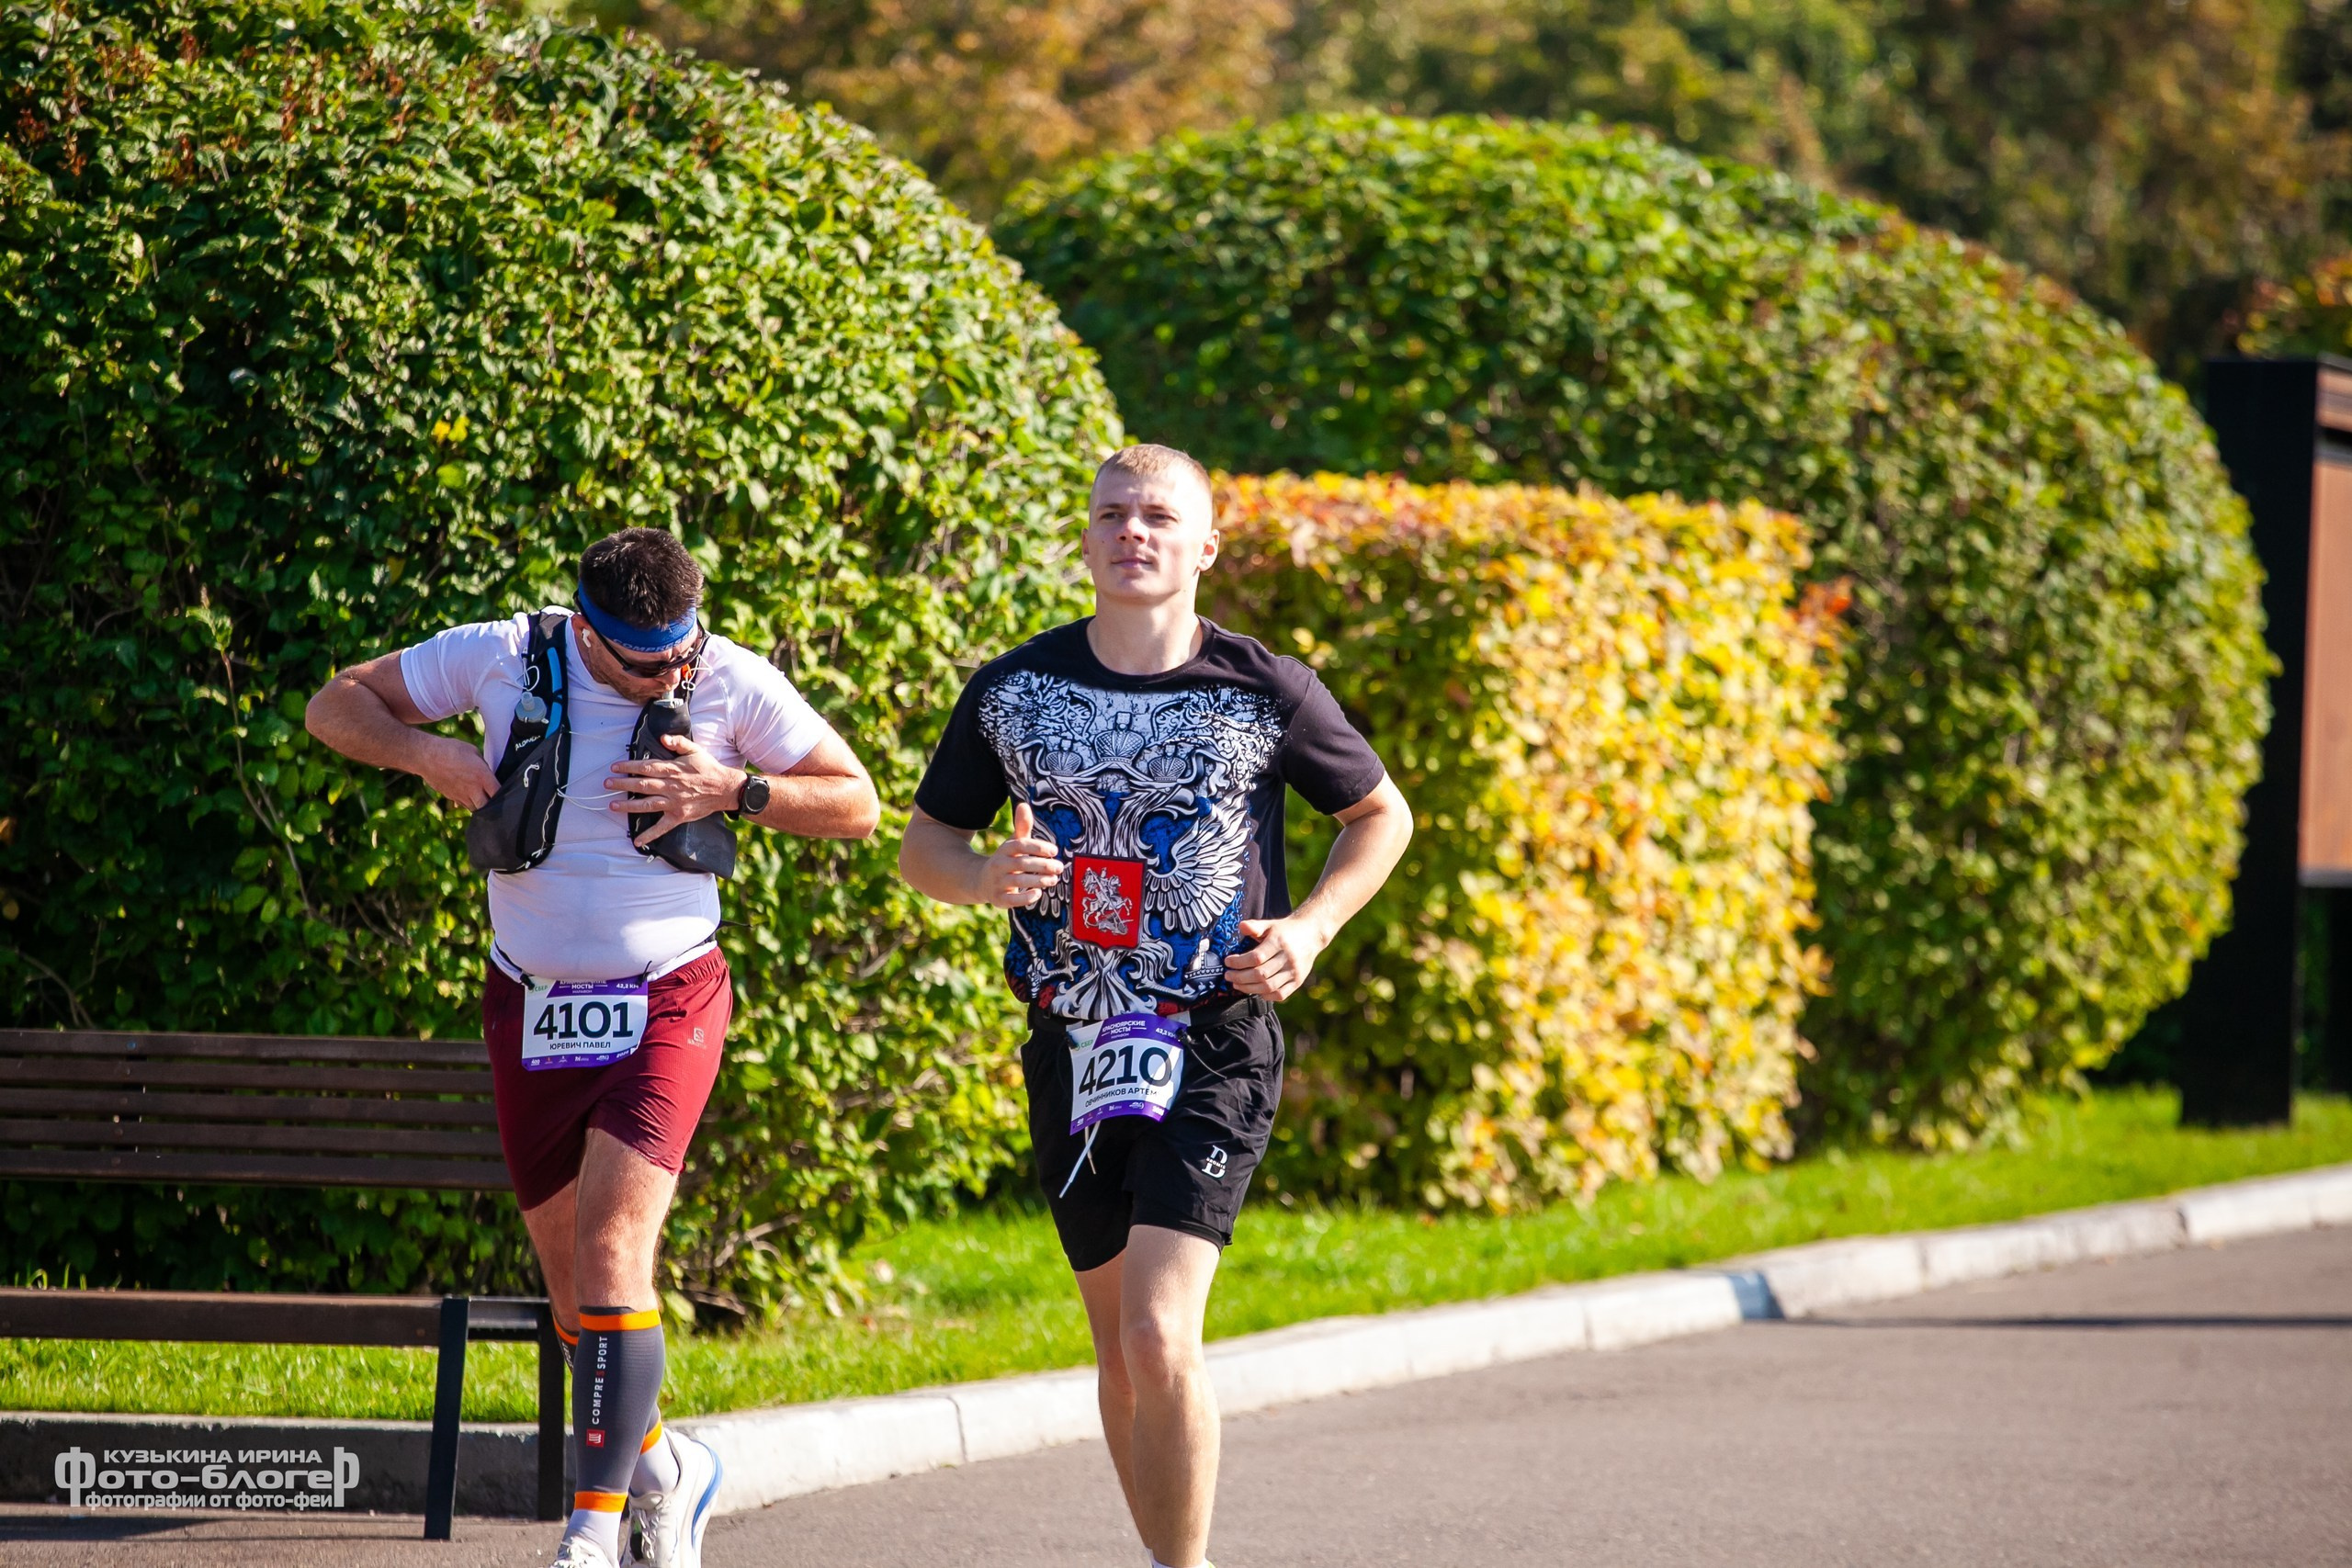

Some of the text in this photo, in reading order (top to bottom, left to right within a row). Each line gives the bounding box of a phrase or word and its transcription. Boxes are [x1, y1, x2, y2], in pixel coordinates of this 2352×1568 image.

[613, 633, 693, 652] COMPRESS
[533, 1001, 634, 1041] 4101
[1102, 1020, 1146, 1032] КРАСНОЯРСКИЕ
[1110, 1026, 1131, 1034] МОСТЫ
[549, 1041, 611, 1050] ЮРЕВИЧ ПАВЕЛ
[1078, 1044, 1172, 1096] 4210
[1085, 1088, 1126, 1108] ОВЧИННИКОВ
